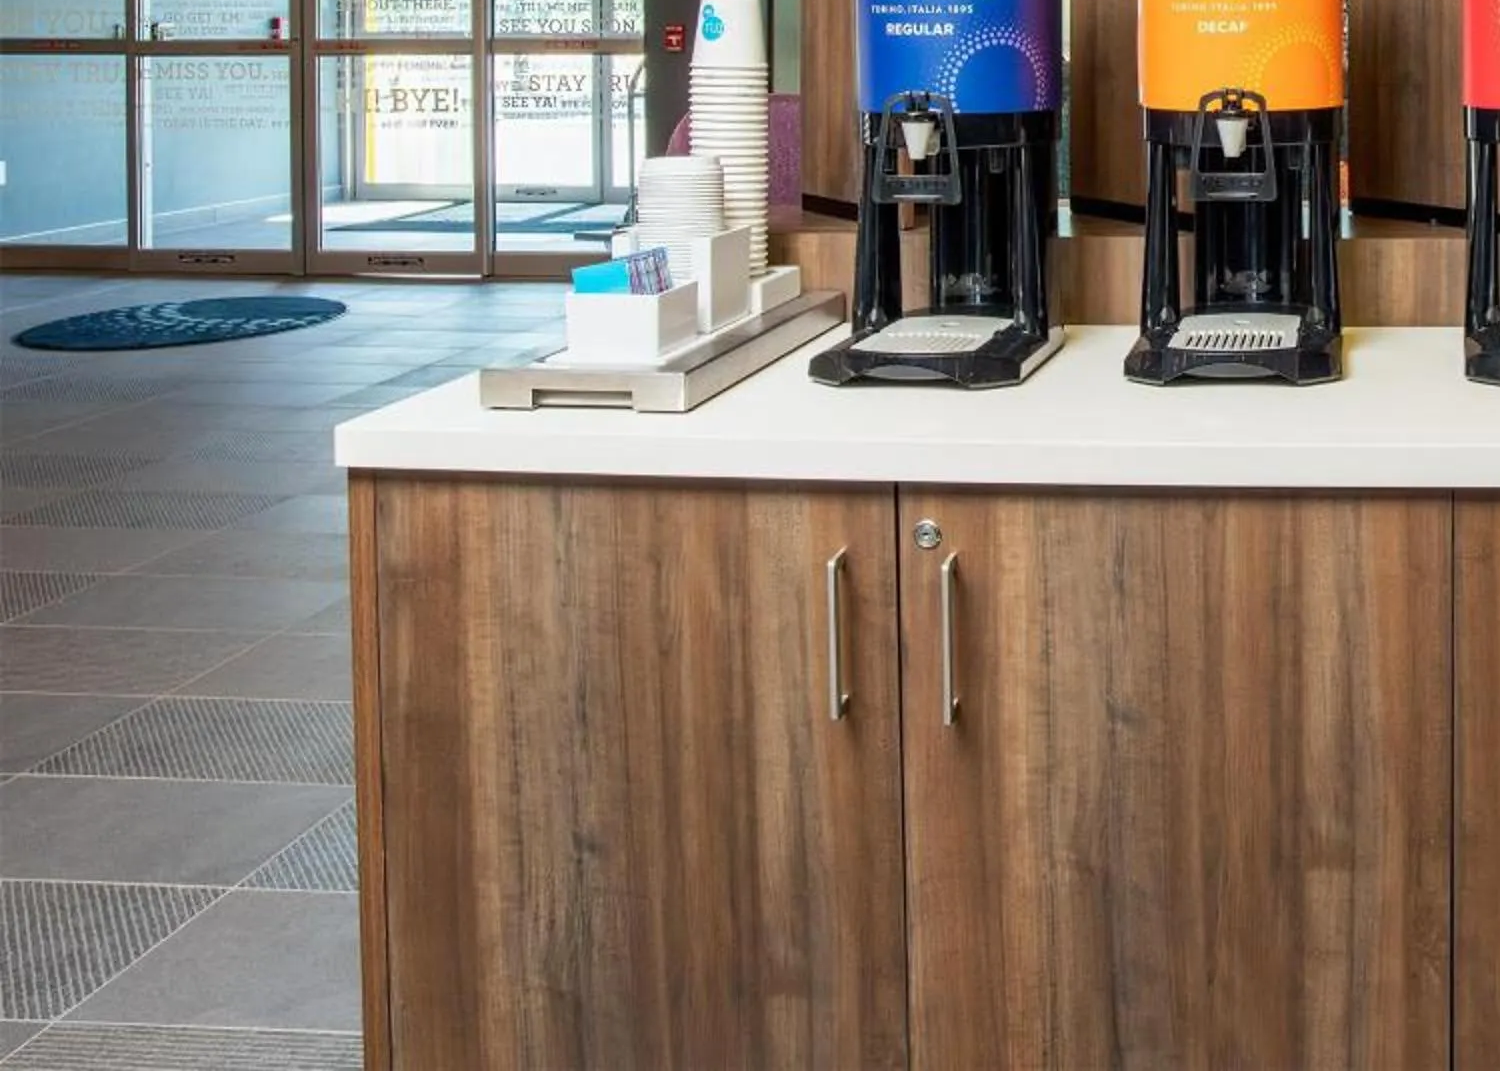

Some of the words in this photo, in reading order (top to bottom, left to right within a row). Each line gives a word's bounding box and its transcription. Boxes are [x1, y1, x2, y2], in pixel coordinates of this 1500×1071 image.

[500, 18, 532, 33] SEE
[537, 18, 575, 33] YOU
[885, 22, 955, 37] REGULAR
[1196, 20, 1248, 33] DECAF
[155, 62, 210, 80] MISS
[214, 62, 269, 80] YOU.
[529, 74, 587, 91] STAY
[389, 88, 459, 113] BYE!
[502, 96, 529, 108] SEE
